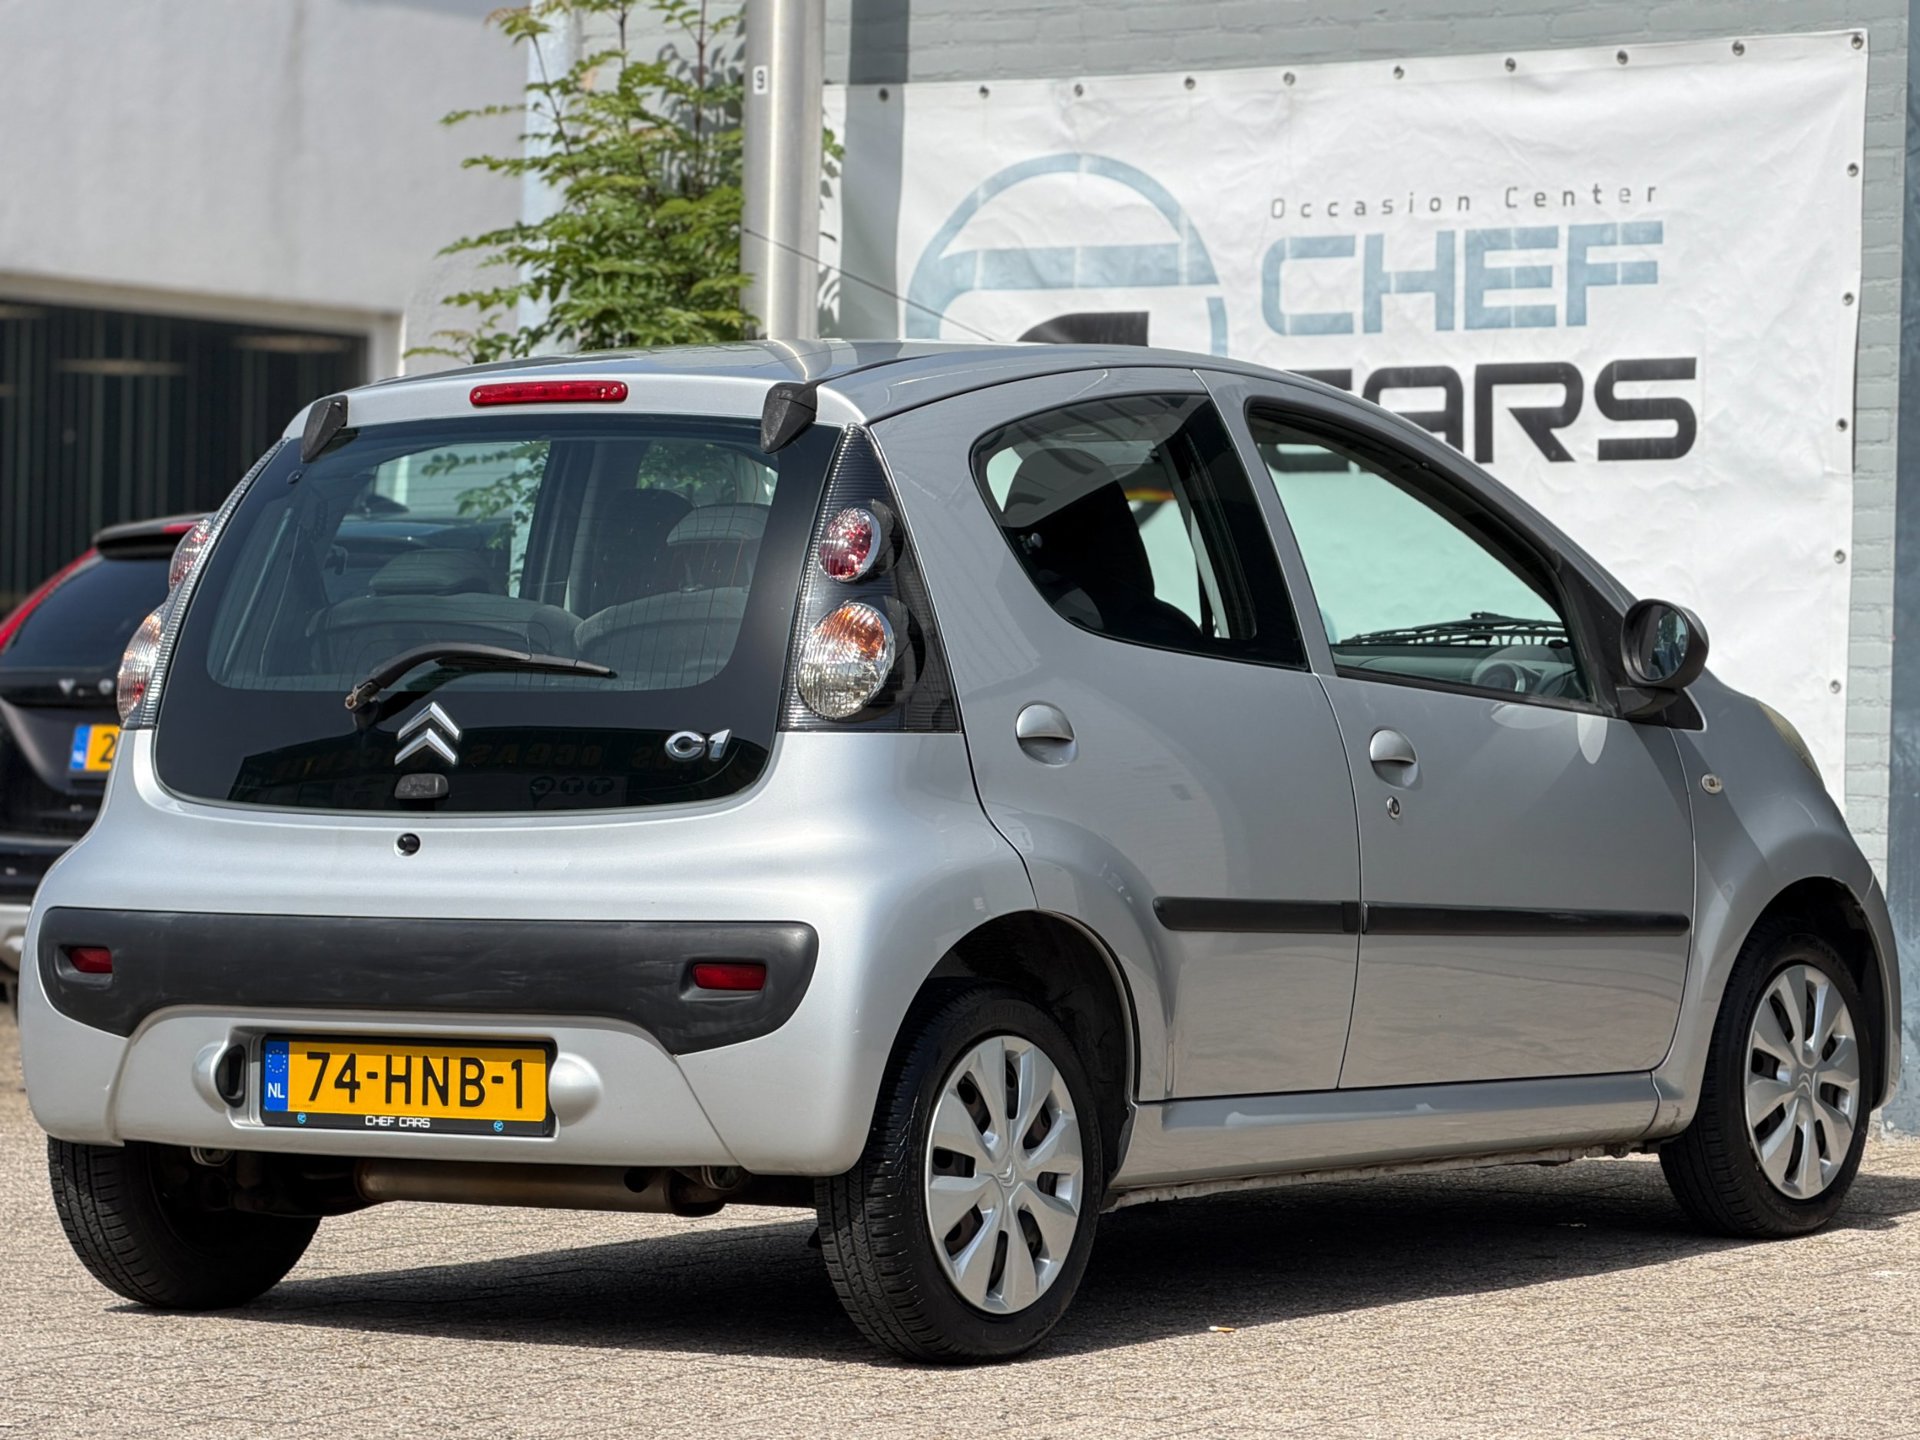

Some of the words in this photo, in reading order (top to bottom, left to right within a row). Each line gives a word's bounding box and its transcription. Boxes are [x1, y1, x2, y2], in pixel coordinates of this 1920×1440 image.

[1271, 193, 1470, 219] Occasion
[1504, 184, 1657, 209] Center
[1261, 220, 1664, 337] CHEF
[664, 729, 732, 762] C1
[267, 1082, 285, 1099] NL
[306, 1051, 524, 1109] 74-HNB-1
[364, 1114, 395, 1127] CHEF
[399, 1116, 431, 1128] CARS
